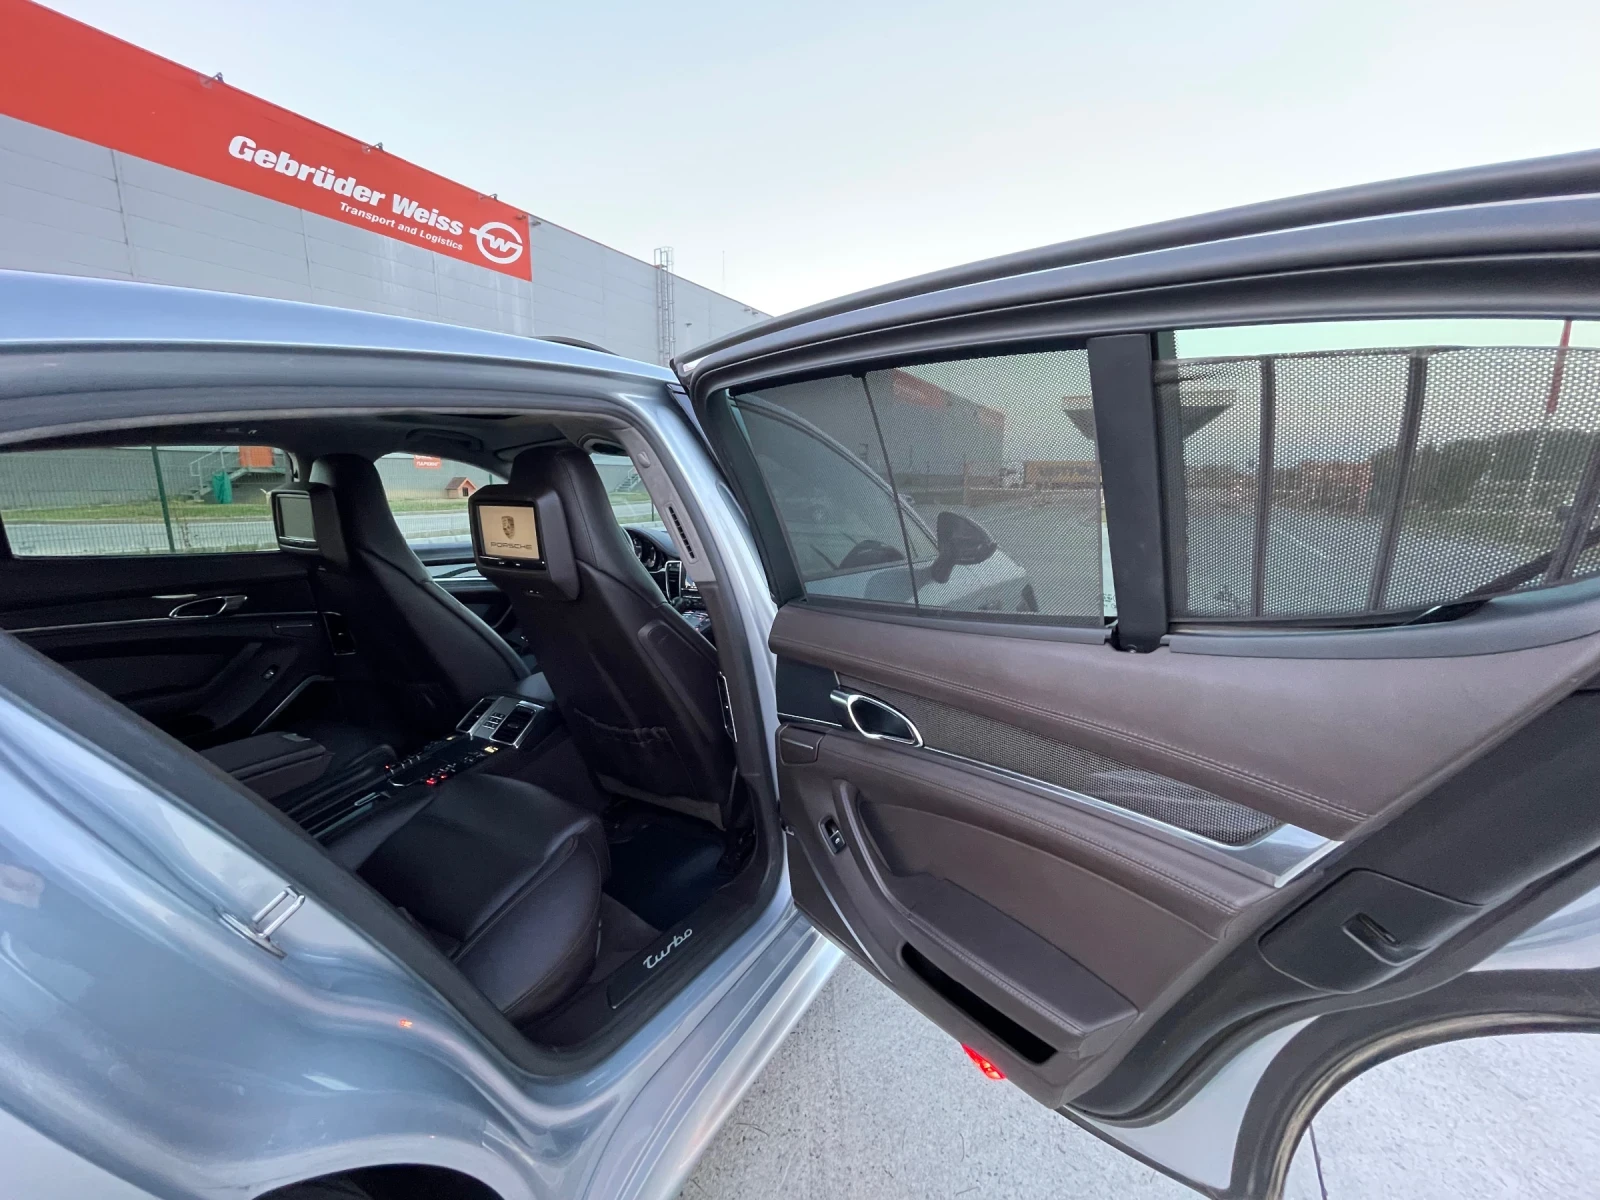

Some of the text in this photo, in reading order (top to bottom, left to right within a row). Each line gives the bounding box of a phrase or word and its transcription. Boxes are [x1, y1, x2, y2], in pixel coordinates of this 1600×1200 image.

[228, 135, 464, 236] Gebrüder Weiss
[340, 201, 463, 251] Transport and Logistics
[490, 541, 533, 550] PORSCHE
